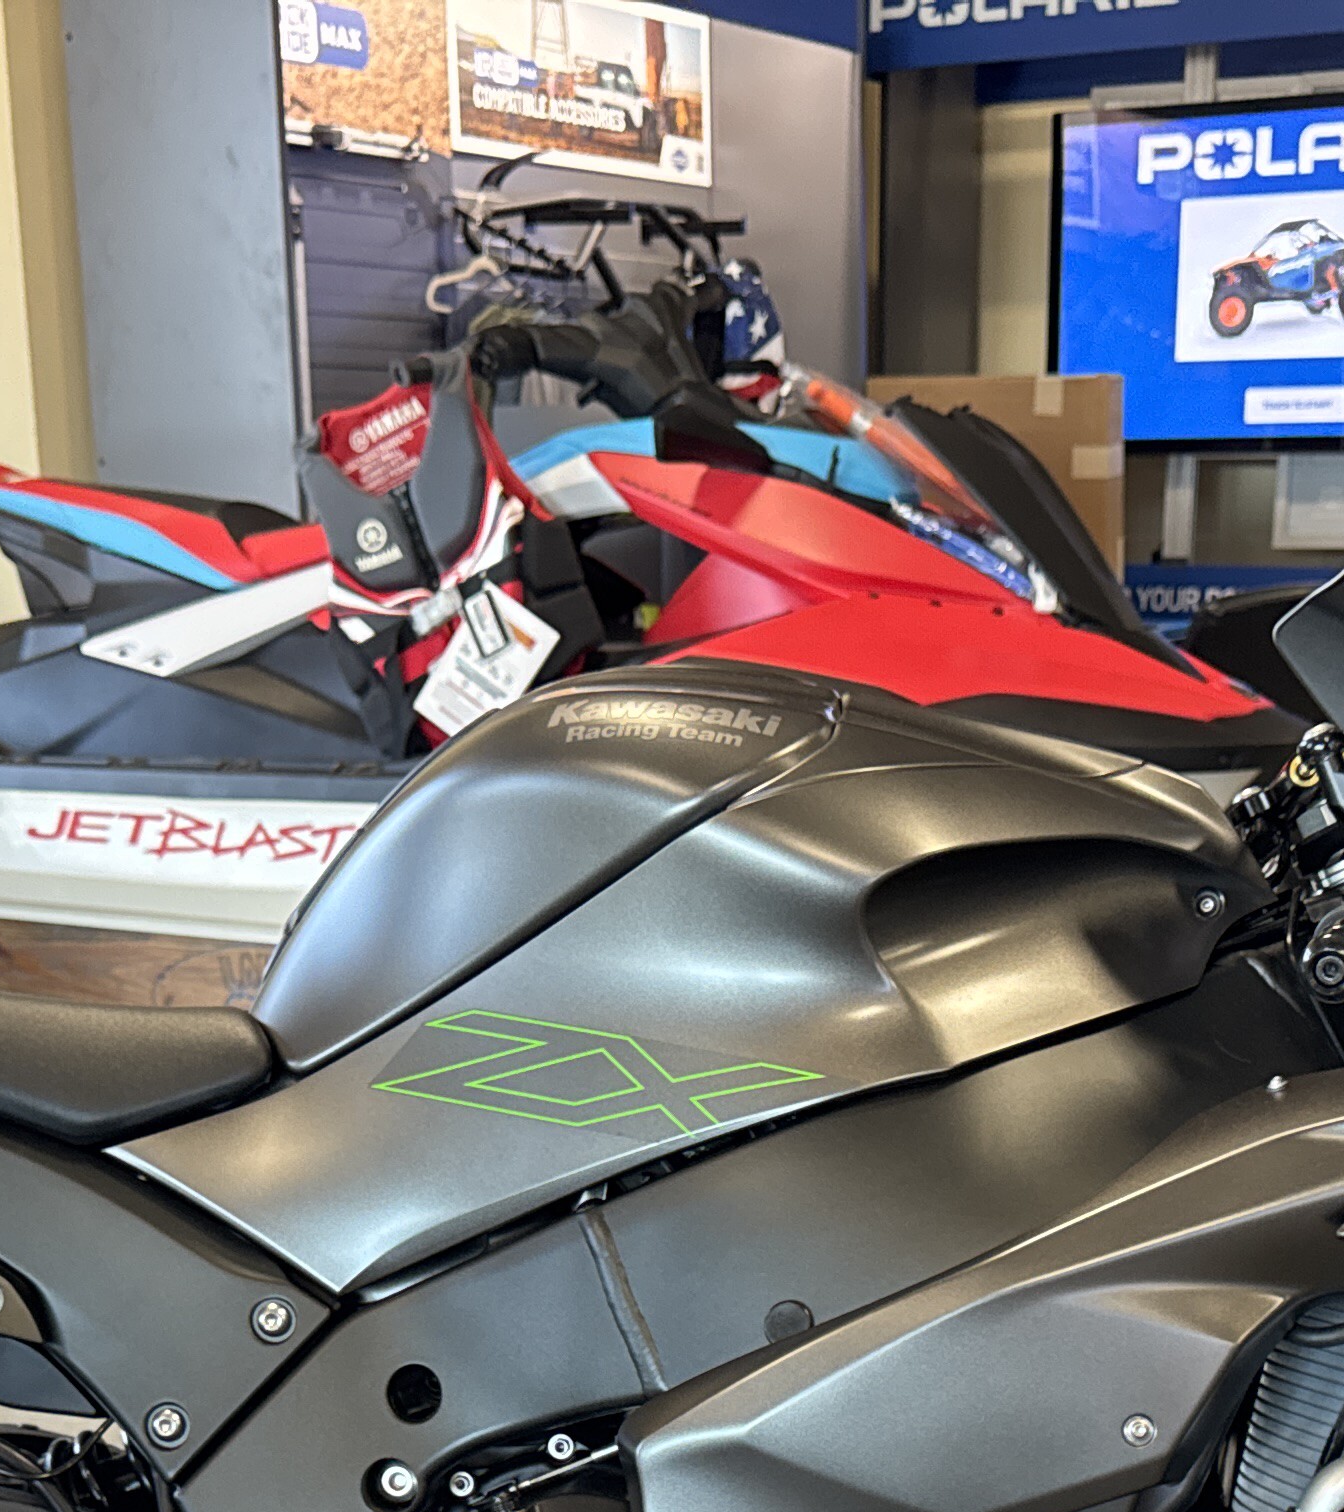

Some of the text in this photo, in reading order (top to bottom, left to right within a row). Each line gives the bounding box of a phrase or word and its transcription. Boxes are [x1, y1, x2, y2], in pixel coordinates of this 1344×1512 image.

[362, 395, 427, 443] YAMAHA
[1135, 585, 1201, 613] YOUR
[547, 699, 783, 737] Kawasaki
[565, 721, 744, 748] Racing Team
[370, 1009, 826, 1139] ZX
